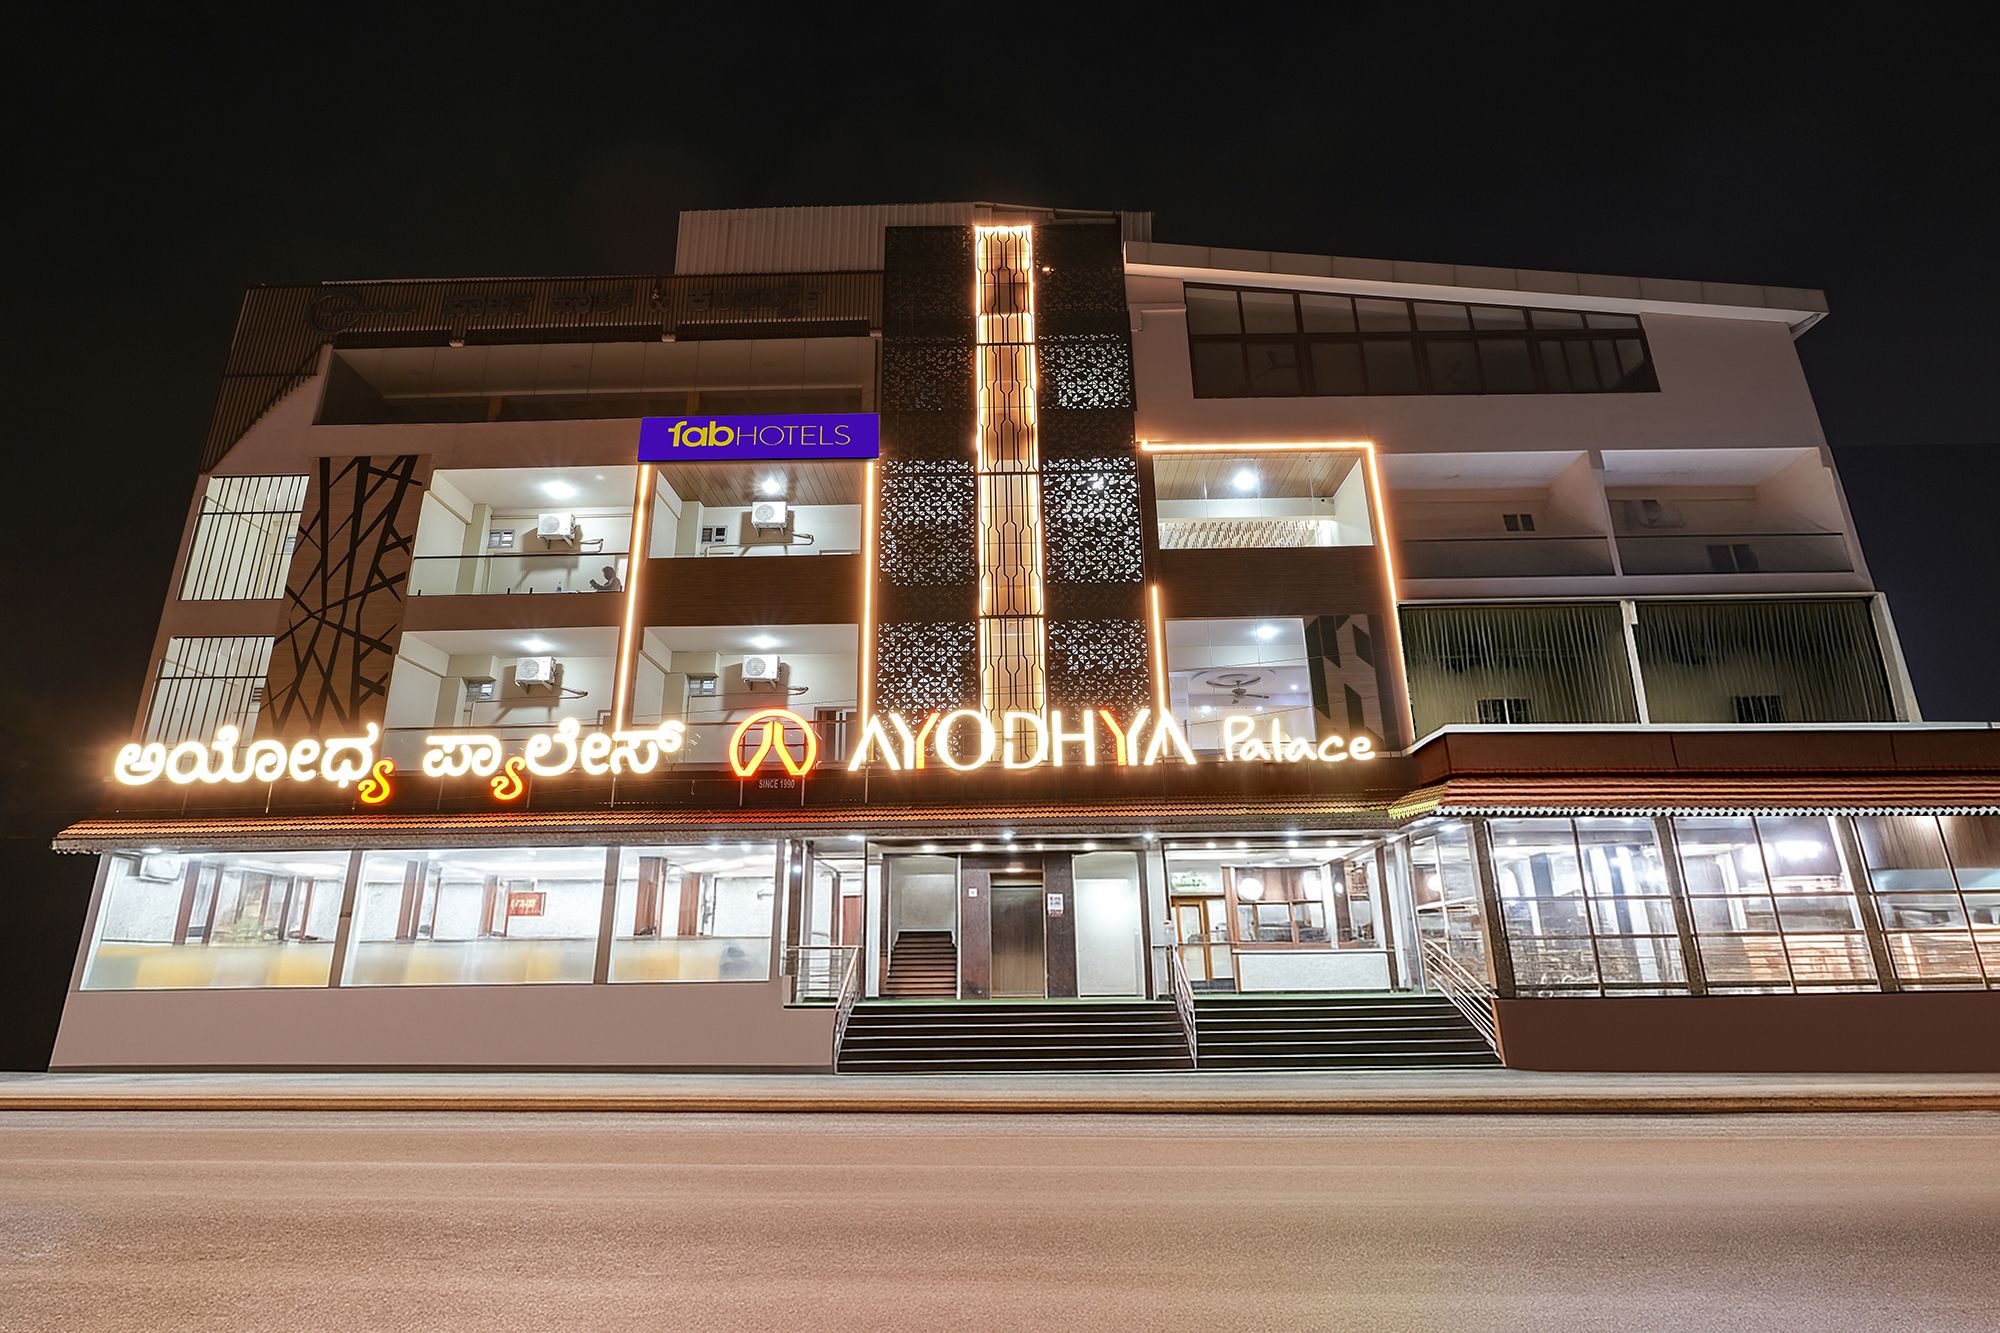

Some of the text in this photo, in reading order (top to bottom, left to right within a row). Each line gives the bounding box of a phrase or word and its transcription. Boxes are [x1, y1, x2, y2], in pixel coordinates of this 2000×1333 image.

[114, 717, 686, 803] ಅಯೋಧ್ಯ ಪ್ಯಾಲೇಸ್
[848, 708, 1376, 772] AYODHYA Palace
[758, 778, 796, 789] SINCE 1990
